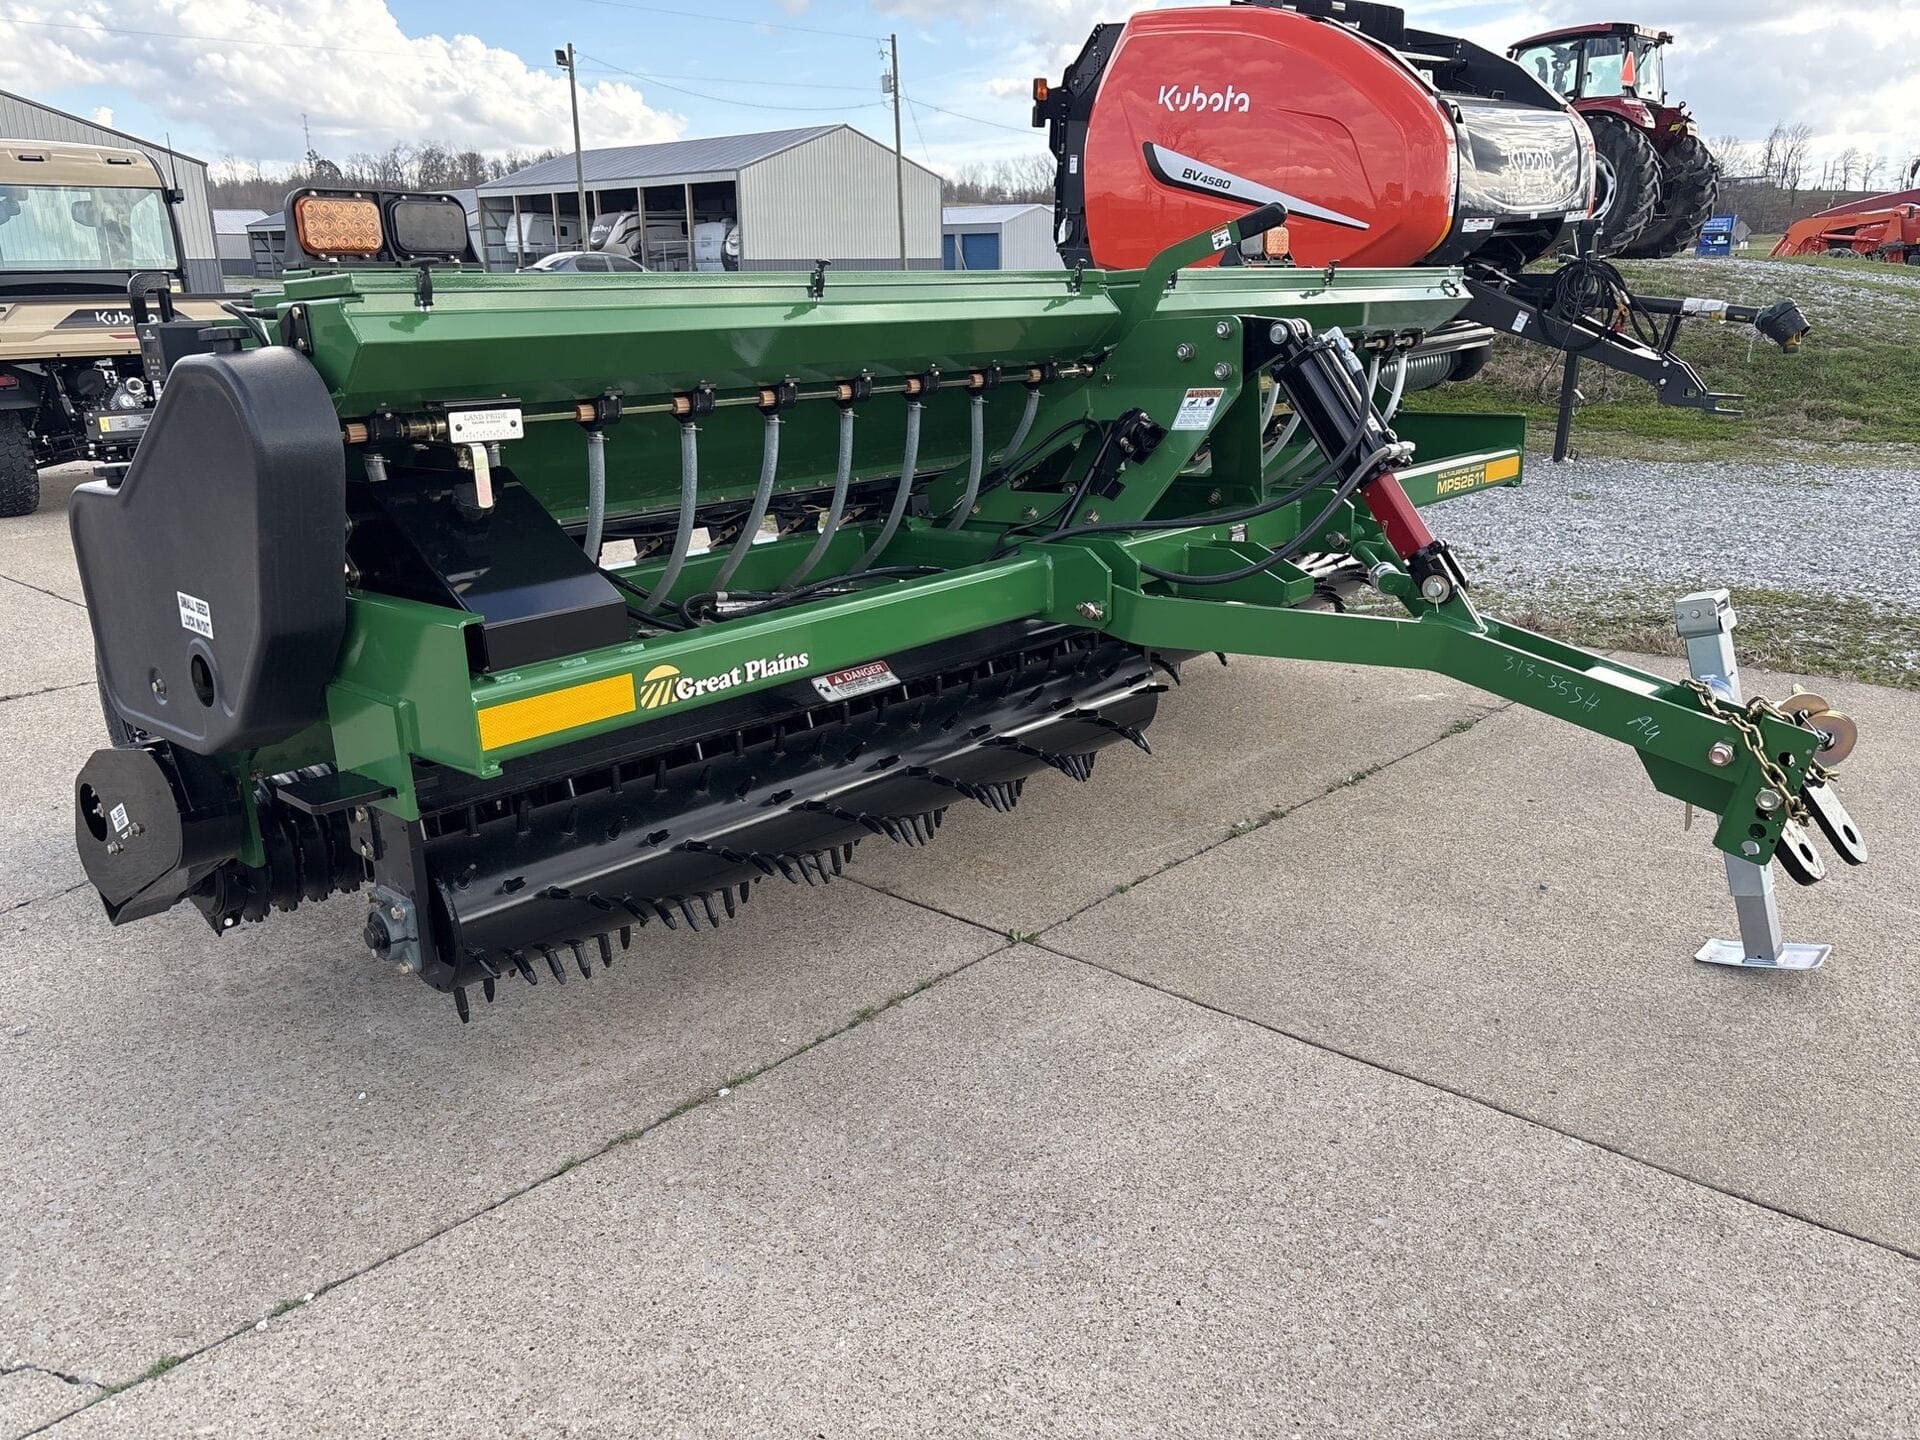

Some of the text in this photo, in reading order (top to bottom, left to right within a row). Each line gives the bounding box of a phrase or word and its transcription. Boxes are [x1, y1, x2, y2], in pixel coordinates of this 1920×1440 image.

[1158, 85, 1250, 112] Kubota
[1182, 168, 1232, 189] BV4580
[94, 311, 159, 325] Kuba
[1436, 471, 1486, 496] MPS2611
[675, 652, 810, 700] Great Plains
[843, 663, 885, 682] DANGER
